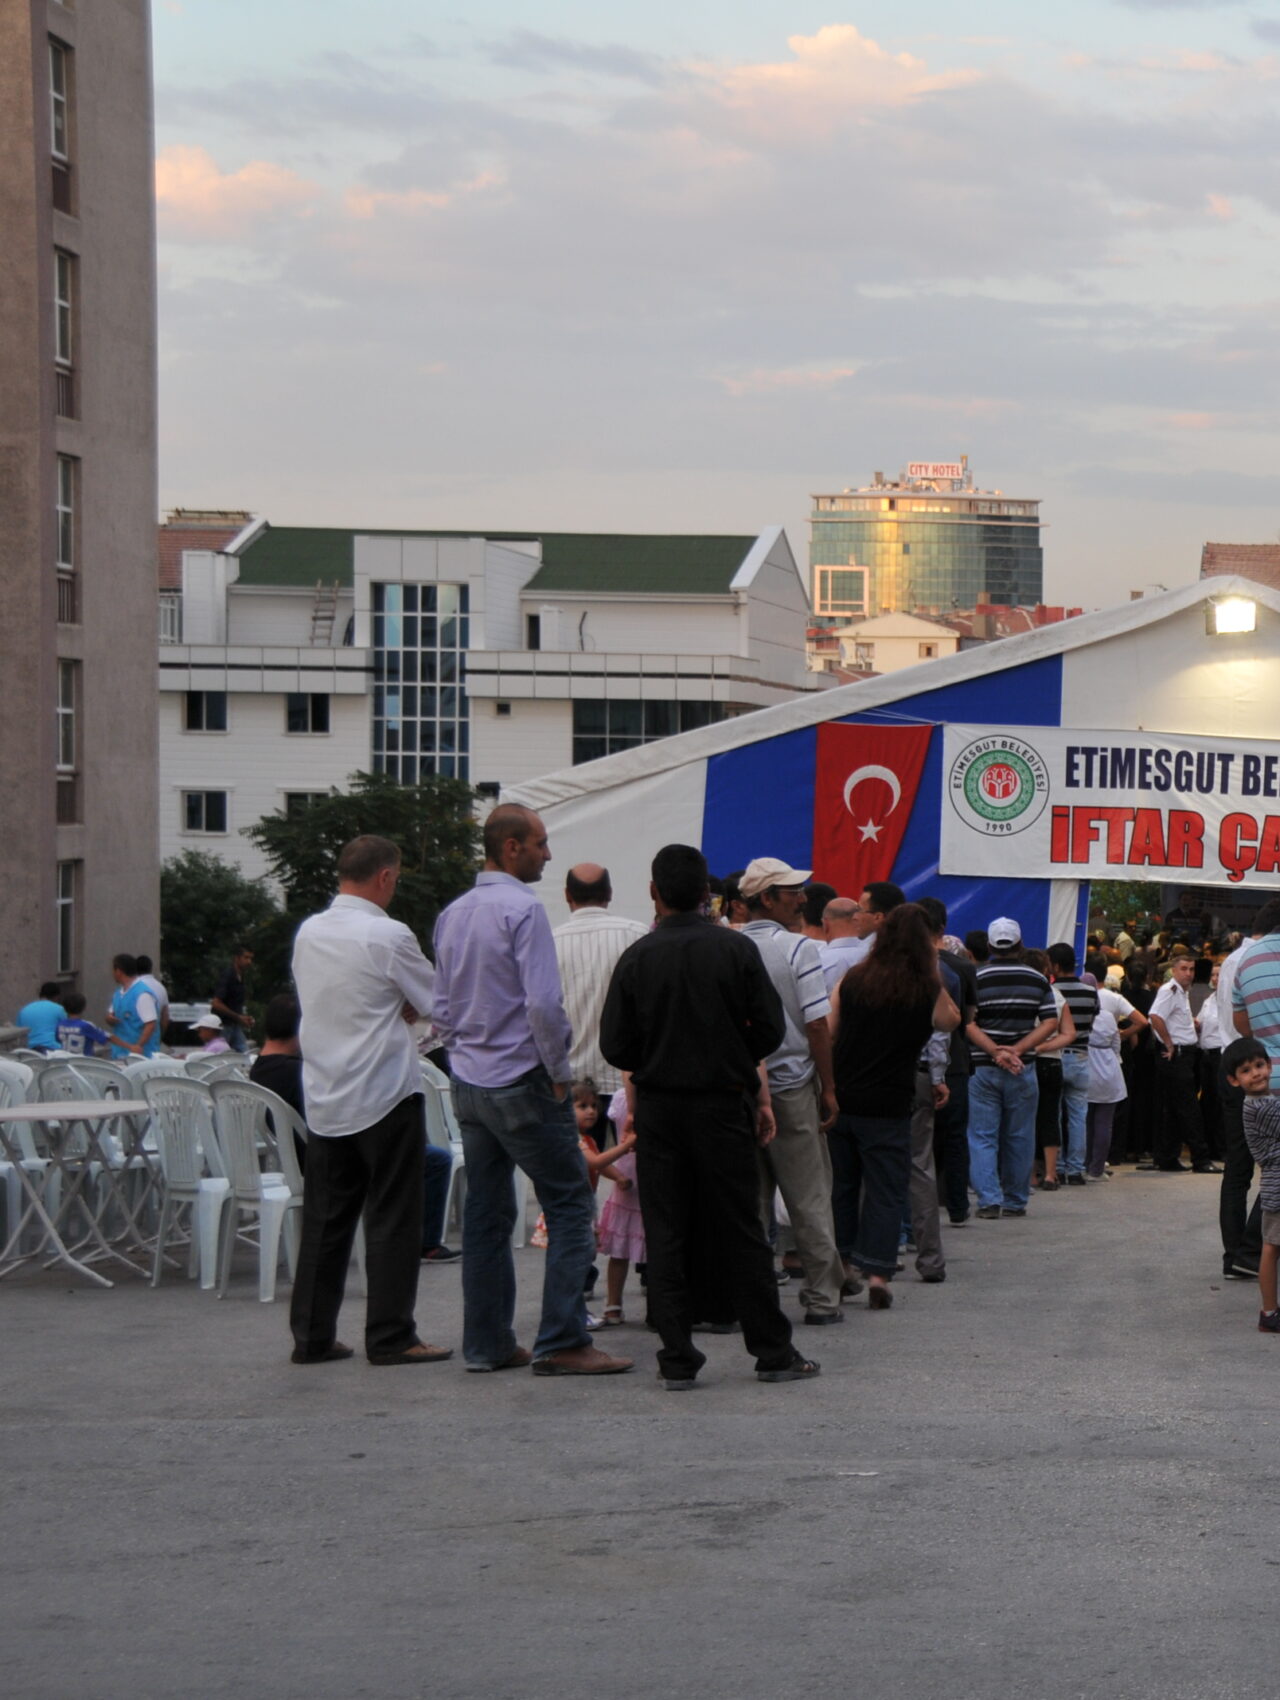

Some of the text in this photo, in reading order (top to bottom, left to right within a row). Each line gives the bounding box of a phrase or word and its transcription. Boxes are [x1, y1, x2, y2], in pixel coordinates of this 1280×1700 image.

[910, 464, 961, 477] CITY HOTEL
[985, 822, 1012, 833] 1990
